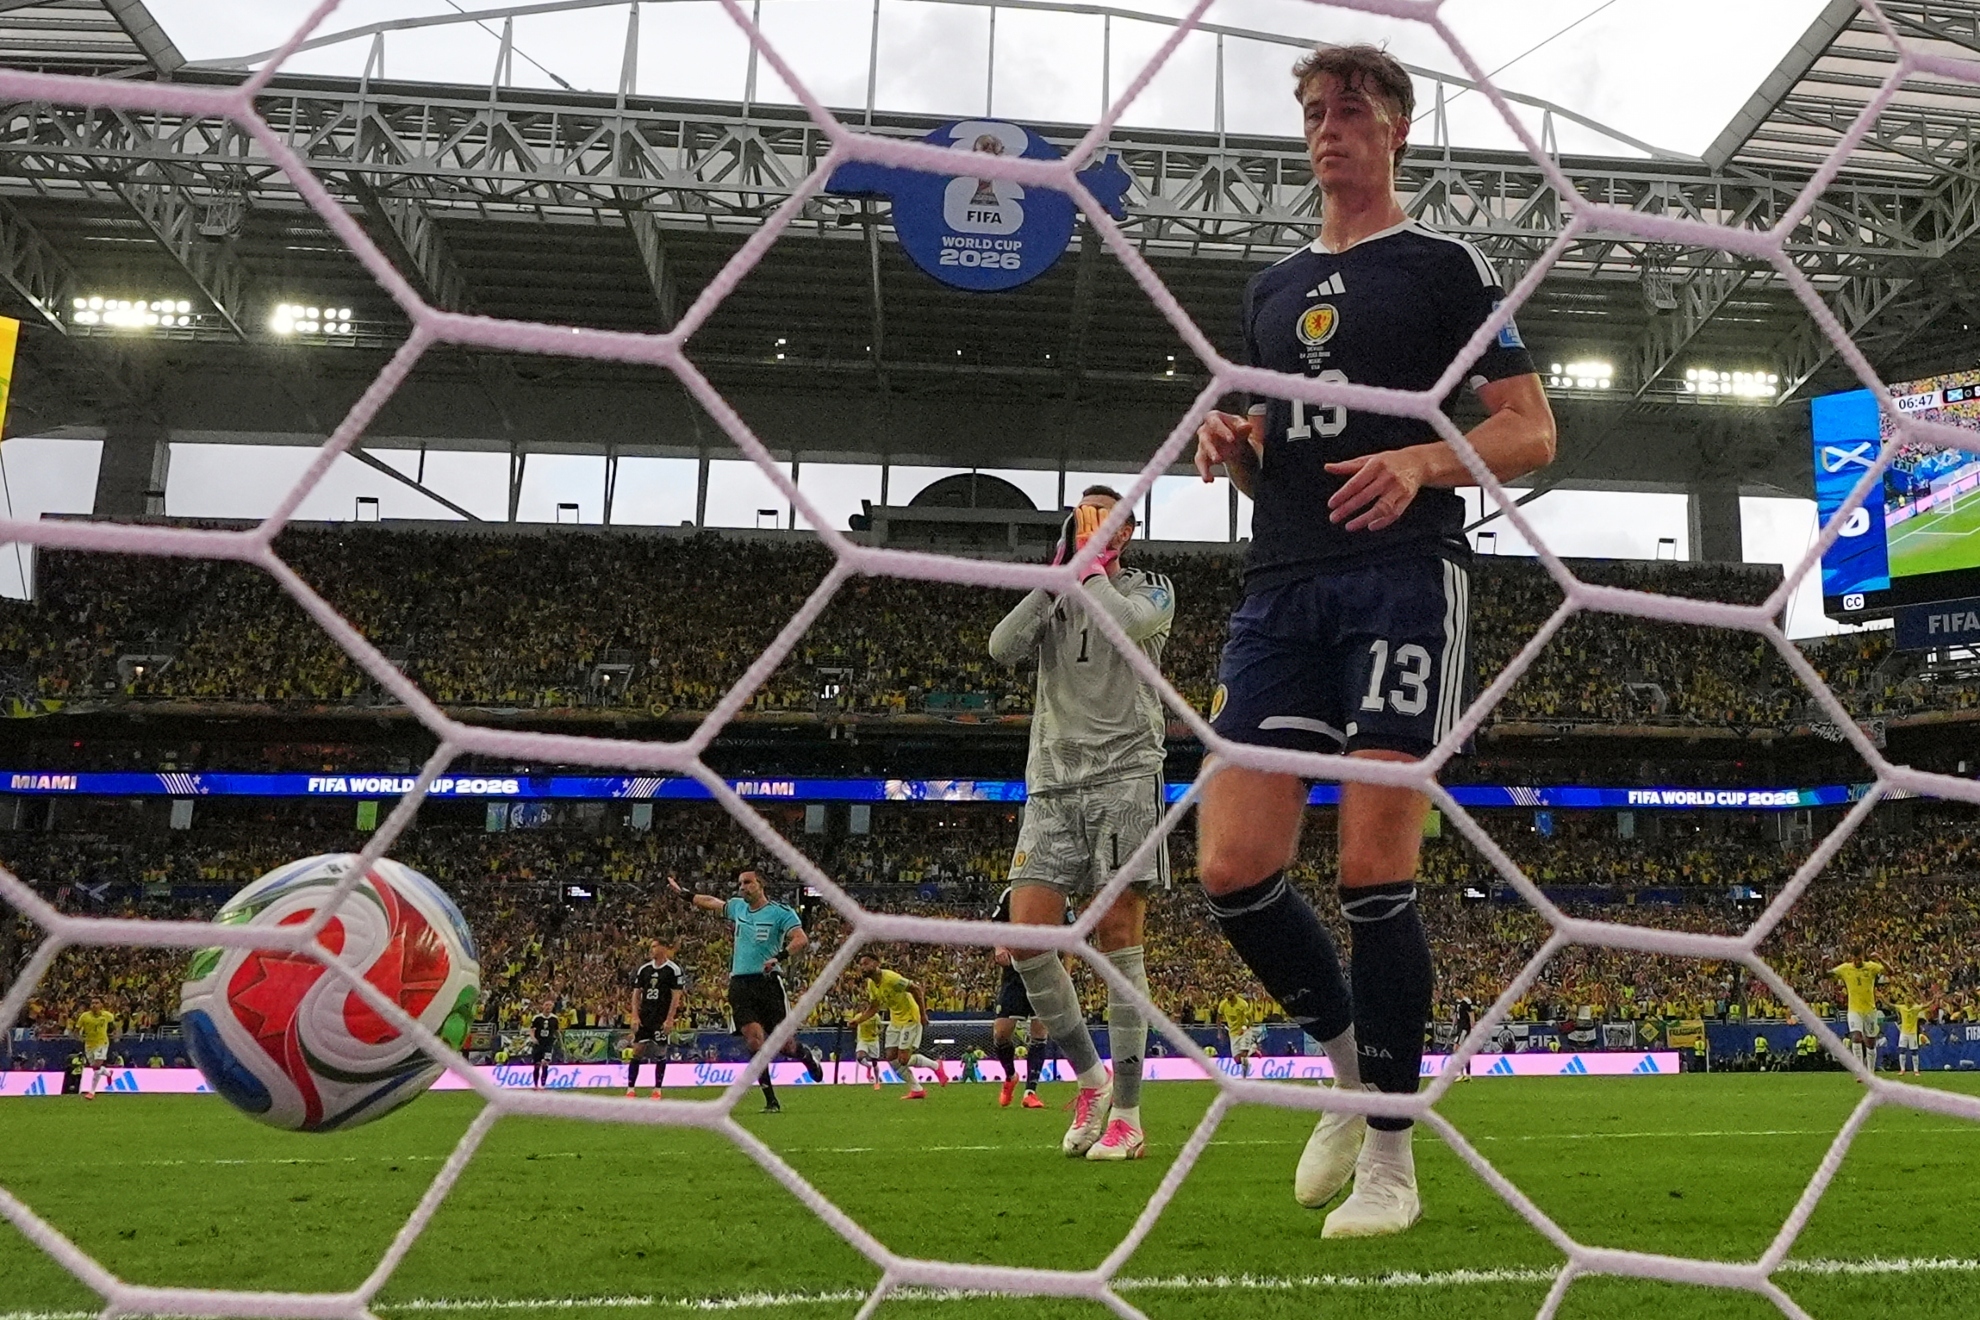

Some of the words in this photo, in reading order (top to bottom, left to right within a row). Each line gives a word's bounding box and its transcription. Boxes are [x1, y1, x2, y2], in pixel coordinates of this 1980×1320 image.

[966, 210, 1002, 224] FIFA
[942, 236, 992, 248] WORLD
[994, 240, 1022, 251] CUP
[939, 249, 1021, 270] 2026
[1286, 368, 1349, 442] 13
[1898, 394, 1934, 410] 06:47
[1845, 596, 1862, 608] CC
[1928, 611, 1980, 635] FIFA
[1076, 628, 1089, 663] 1
[1359, 639, 1432, 717] 13
[11, 774, 77, 790] MIAMI
[307, 777, 348, 793] FIFA
[350, 778, 415, 793] WORLD
[455, 779, 520, 794] 2026
[735, 781, 795, 796] MIAMI
[1628, 791, 1660, 805] FIFA
[1661, 791, 1716, 806] WORLD
[1717, 792, 1747, 806] CUP
[1748, 791, 1800, 806] 2026
[1109, 832, 1121, 870] 1
[646, 988, 659, 1000] 23
[492, 1064, 533, 1087] You
[694, 1063, 735, 1086] You
[1262, 1059, 1295, 1079] Got
